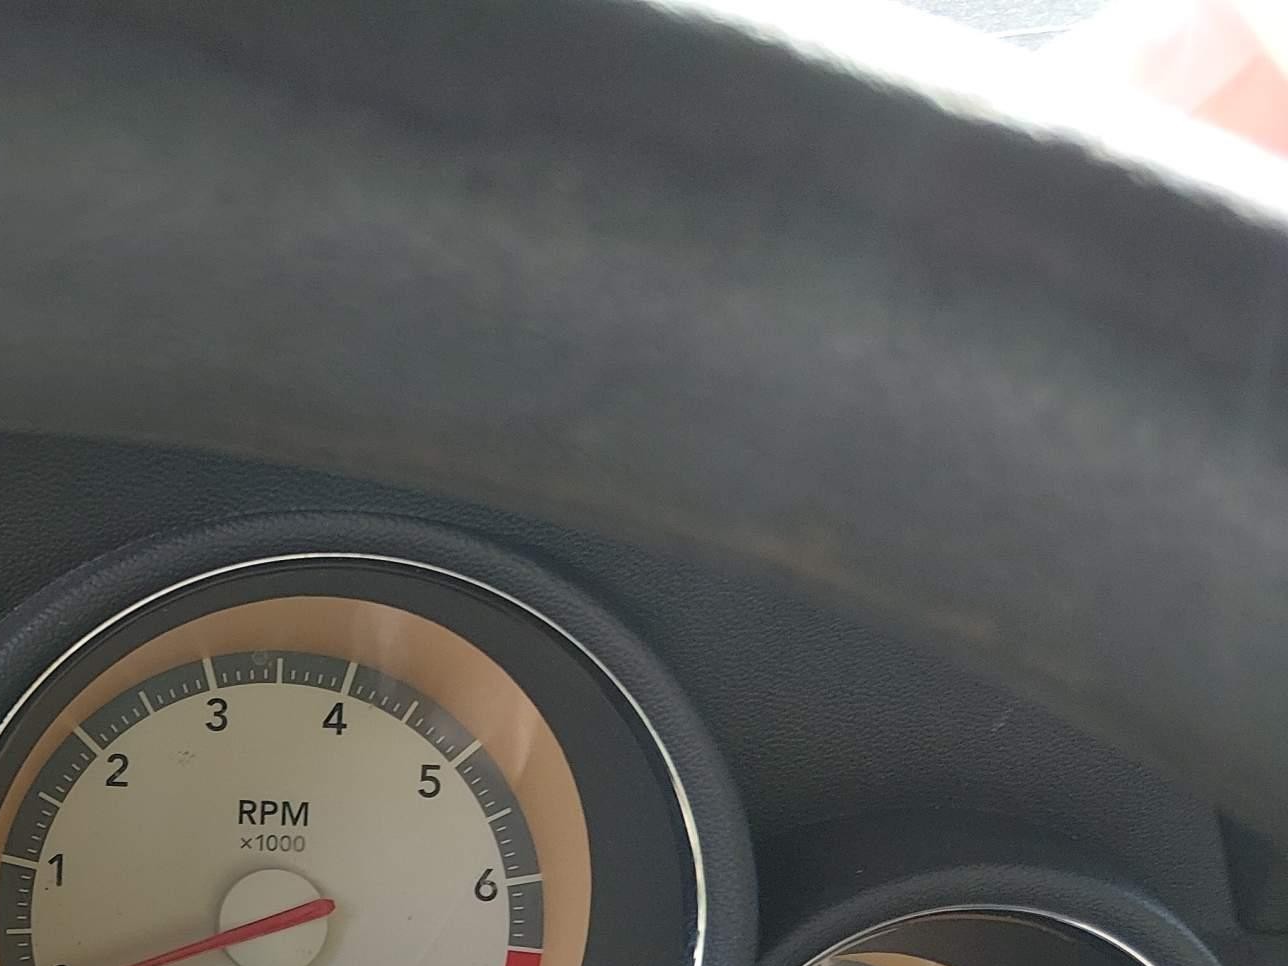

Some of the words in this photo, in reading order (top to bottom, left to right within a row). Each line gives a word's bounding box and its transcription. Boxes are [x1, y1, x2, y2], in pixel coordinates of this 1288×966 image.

[205, 697, 229, 732] 3
[321, 701, 348, 736] 4
[104, 752, 129, 787] 2
[417, 763, 442, 798] 5
[237, 799, 310, 827] RPM
[47, 853, 65, 887] 1
[473, 868, 499, 902] 6
